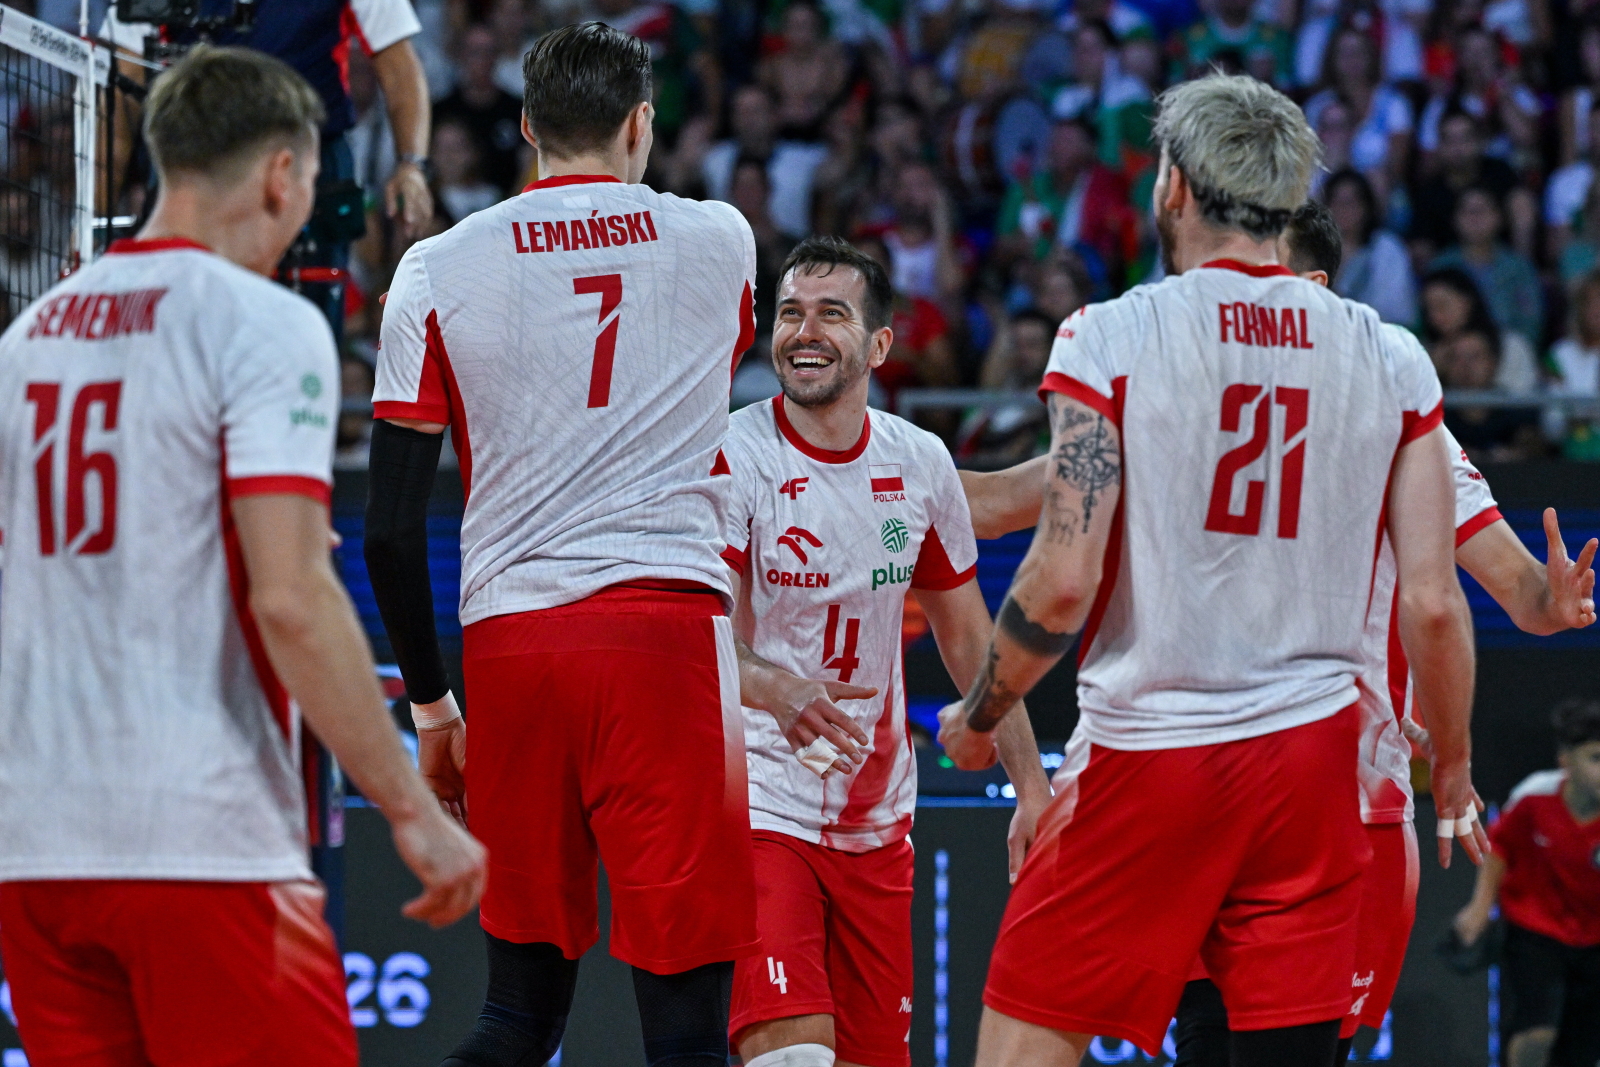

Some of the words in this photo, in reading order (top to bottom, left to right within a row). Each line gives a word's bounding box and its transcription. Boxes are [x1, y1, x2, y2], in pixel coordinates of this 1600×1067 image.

[511, 210, 659, 254] LEMAŃSKI
[572, 273, 623, 409] 7
[1218, 301, 1314, 349] FORNAL
[25, 379, 124, 556] 16
[1203, 383, 1310, 540] 21
[779, 476, 810, 500] 4F
[873, 493, 907, 503] POLSKA
[766, 568, 830, 588] ORLEN
[871, 562, 914, 591] plus
[821, 604, 861, 684] 4
[767, 956, 788, 995] 4
